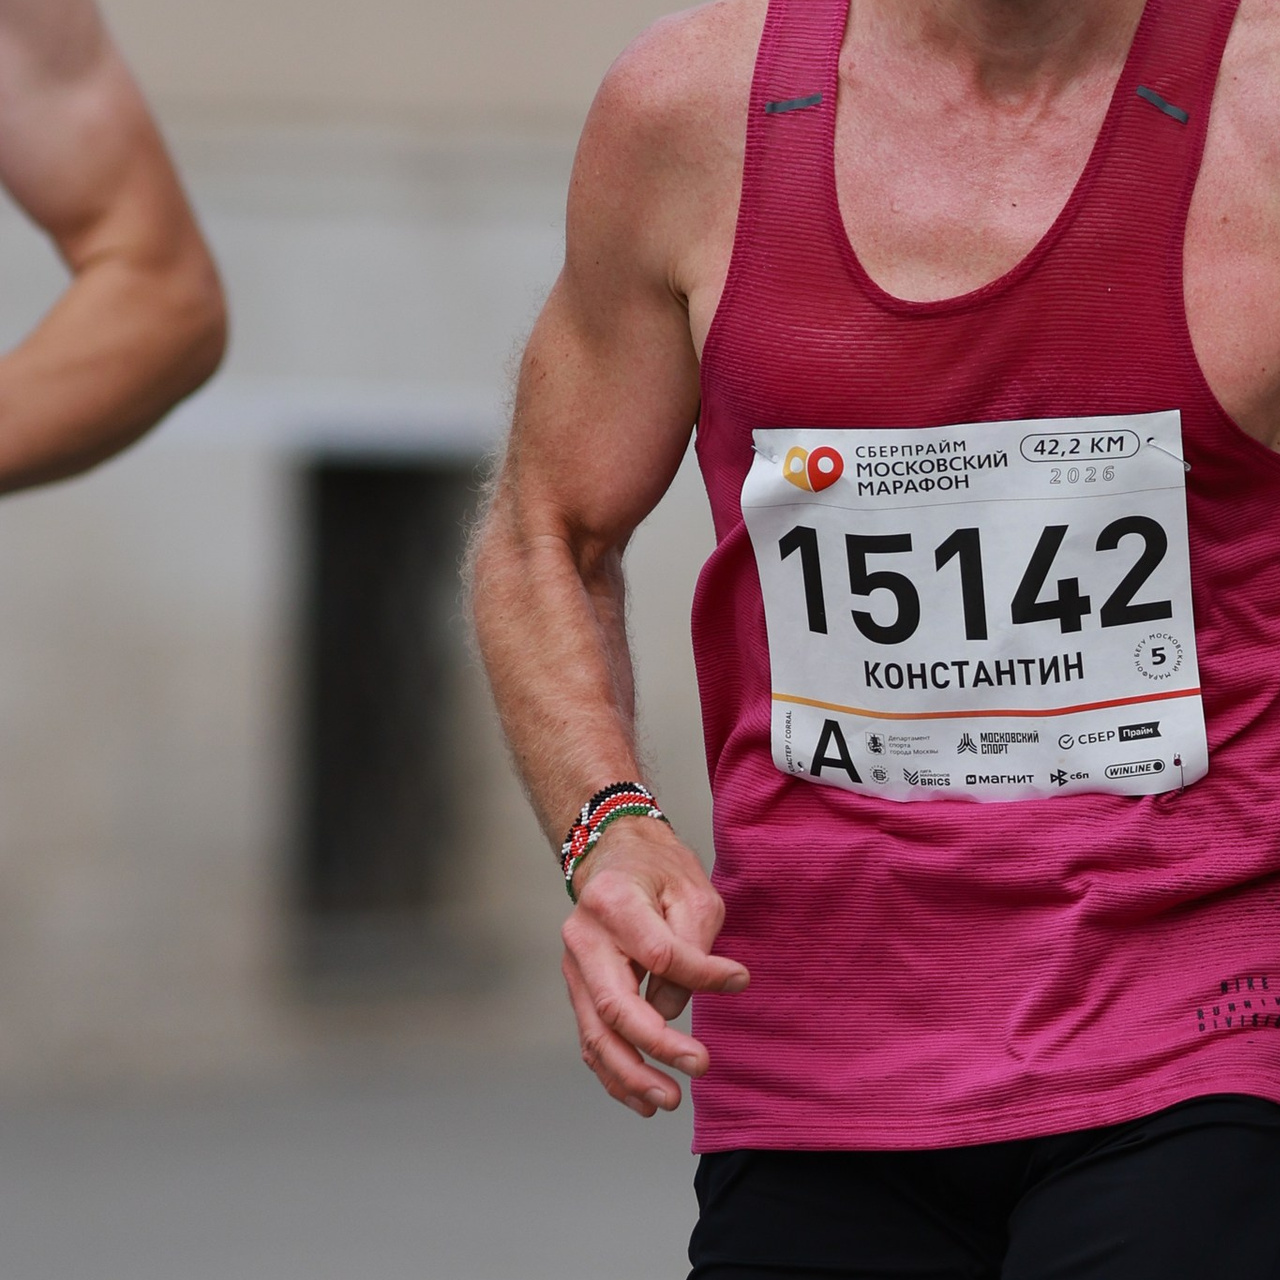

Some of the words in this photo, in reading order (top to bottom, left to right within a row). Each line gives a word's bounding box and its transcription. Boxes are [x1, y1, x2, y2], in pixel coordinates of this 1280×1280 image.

[855, 439, 967, 458] СБЕРПРАЙМ
[1033, 438, 1081, 457] 42,2
[856, 450, 1008, 478] МОСКОВСКИЙ
[1049, 465, 1115, 484] 2026
[857, 474, 970, 497] МАРАФОН
[778, 515, 1173, 645] 15142
[1151, 646, 1166, 665] 5
[864, 651, 1085, 690] КОНСТАНТИН
[784, 710, 792, 739] CORRAL
[980, 730, 1040, 743] МОСКОВСКИЙ
[1077, 730, 1116, 745] СБЕР
[1122, 726, 1154, 738] Прайм
[981, 744, 1008, 755] СПОРТ
[978, 774, 1035, 784] магнит
[1069, 772, 1090, 780] сбп
[1109, 763, 1152, 776] WINLINE
[920, 778, 951, 786] BRICS
[1221, 976, 1269, 994] NIKE
